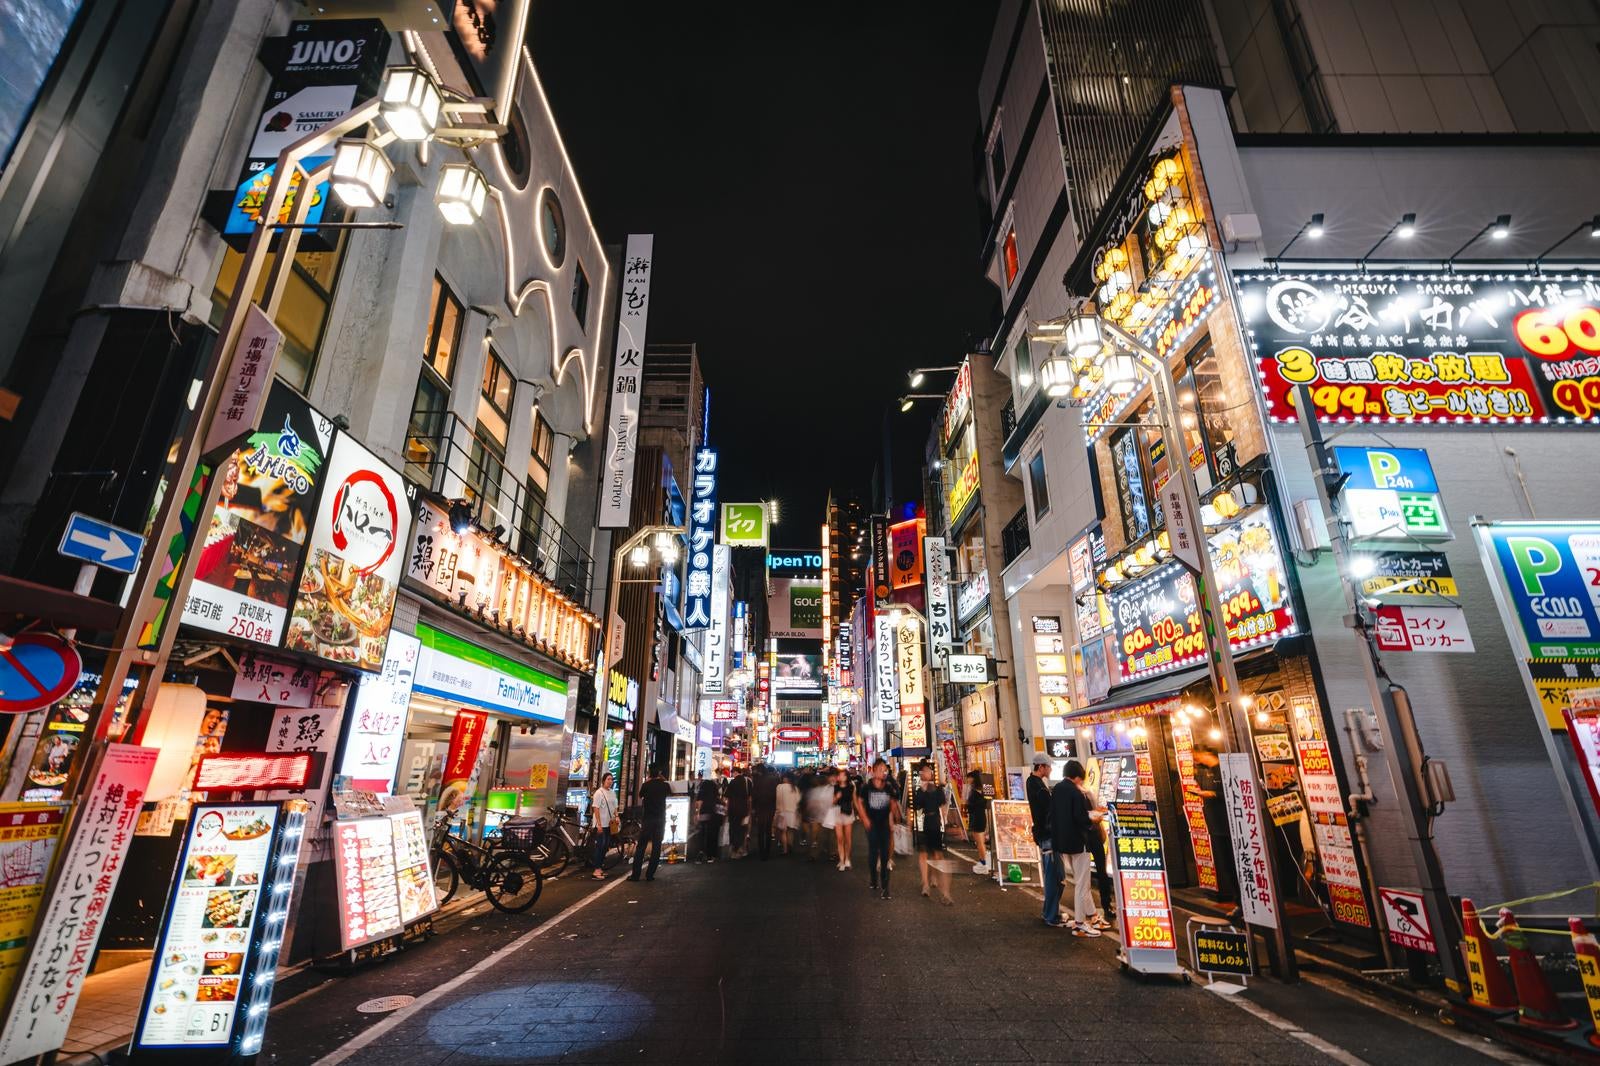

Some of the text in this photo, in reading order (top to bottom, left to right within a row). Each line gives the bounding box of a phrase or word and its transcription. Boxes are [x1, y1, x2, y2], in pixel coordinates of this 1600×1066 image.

[287, 39, 356, 64] UNO
[627, 277, 646, 285] KAN
[1333, 283, 1474, 296] SHIBUYA SAKABA
[627, 309, 641, 317] KA
[226, 336, 268, 422] 劇場通り一番街
[615, 349, 640, 395] 火鍋
[318, 417, 334, 438] B2
[1366, 450, 1414, 489] P 24h
[611, 468, 625, 510] HOTPOT
[417, 506, 433, 525] 2F
[727, 507, 757, 533] レイク
[1169, 491, 1190, 550] 劇場通り番街
[686, 448, 717, 628] カラオケの鉄人
[1506, 536, 1563, 597] P
[900, 573, 914, 585] 4F
[227, 616, 273, 644] 250名様
[930, 601, 951, 660] ちから
[1407, 616, 1446, 630] コイン
[709, 619, 722, 678] トントン
[1412, 633, 1465, 647] ロッカー
[902, 644, 918, 695] てけてけ
[952, 662, 985, 674] ちから
[257, 685, 291, 702] 入口
[497, 678, 541, 707] FamilyMart
[878, 664, 894, 715] にいむら
[276, 714, 292, 751] 串焼き
[363, 741, 393, 762] 入口
[452, 717, 477, 775] 中華まん
[1302, 757, 1331, 771] 500円
[1117, 837, 1161, 854] 営業中
[1119, 856, 1162, 868] 渋谷サカバ
[1130, 887, 1165, 901] 500円
[1335, 902, 1368, 923] 60円
[1133, 927, 1172, 941] 500円
[211, 1012, 229, 1032] B1
